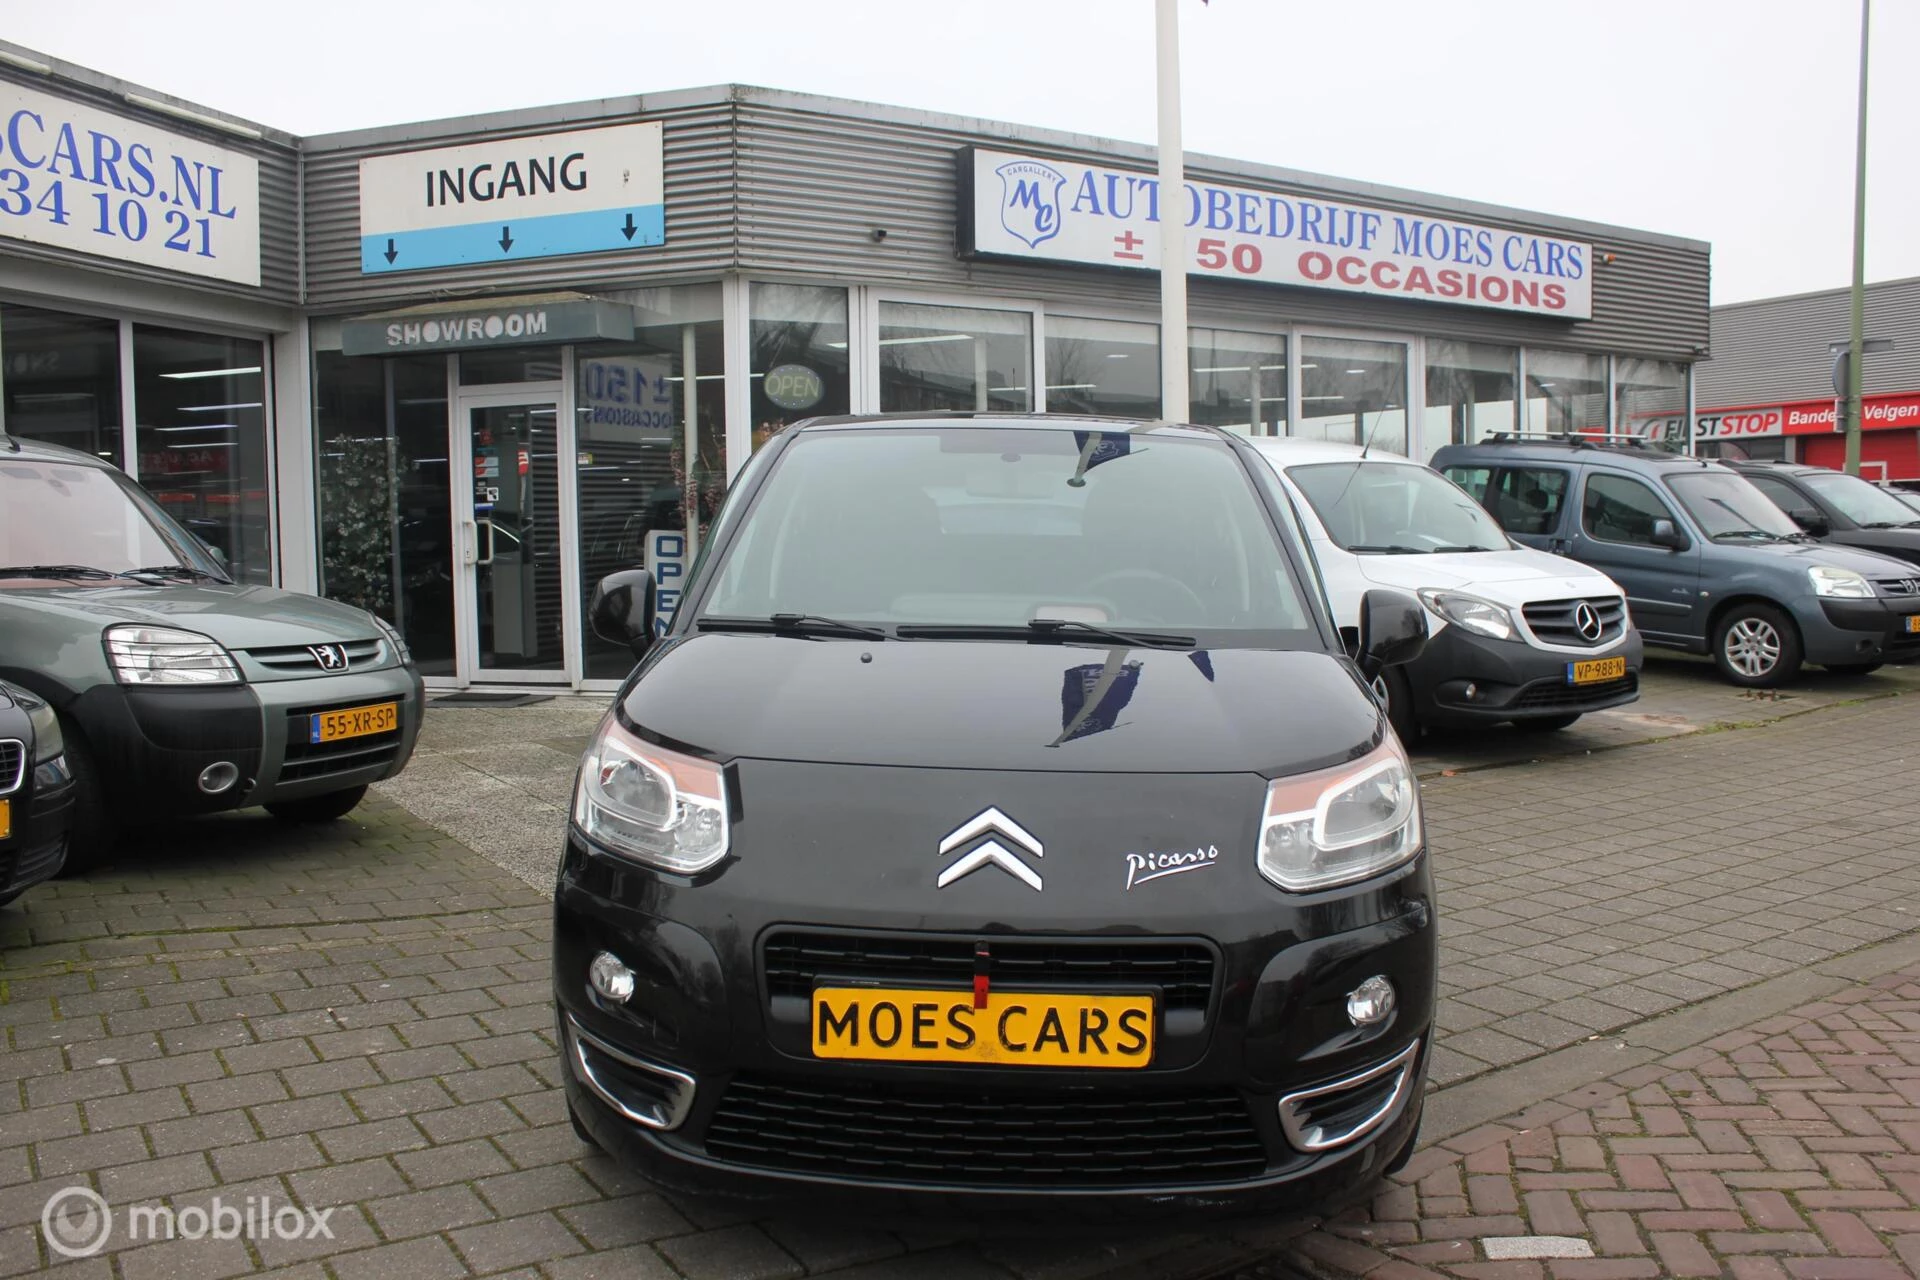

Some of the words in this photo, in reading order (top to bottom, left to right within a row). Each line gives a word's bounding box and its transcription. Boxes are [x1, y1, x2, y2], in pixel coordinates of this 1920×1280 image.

[0, 110, 236, 219] CARS.NL
[426, 152, 588, 207] INGANG
[92, 193, 148, 242] 10
[164, 210, 216, 259] 21
[1392, 217, 1493, 268] MOES
[1503, 235, 1584, 280] CARS
[1298, 251, 1566, 310] OCCASIONS
[386, 311, 548, 346] SHOWROOM
[765, 375, 820, 398] OPEN
[1788, 409, 1838, 425] Bande
[1864, 404, 1919, 422] Velgen
[1577, 660, 1623, 680] VP-988-N
[327, 708, 394, 736] 55-XR-SP
[1126, 845, 1218, 890] Picasso
[818, 1000, 976, 1050] MOES
[997, 1005, 1148, 1056] CARS
